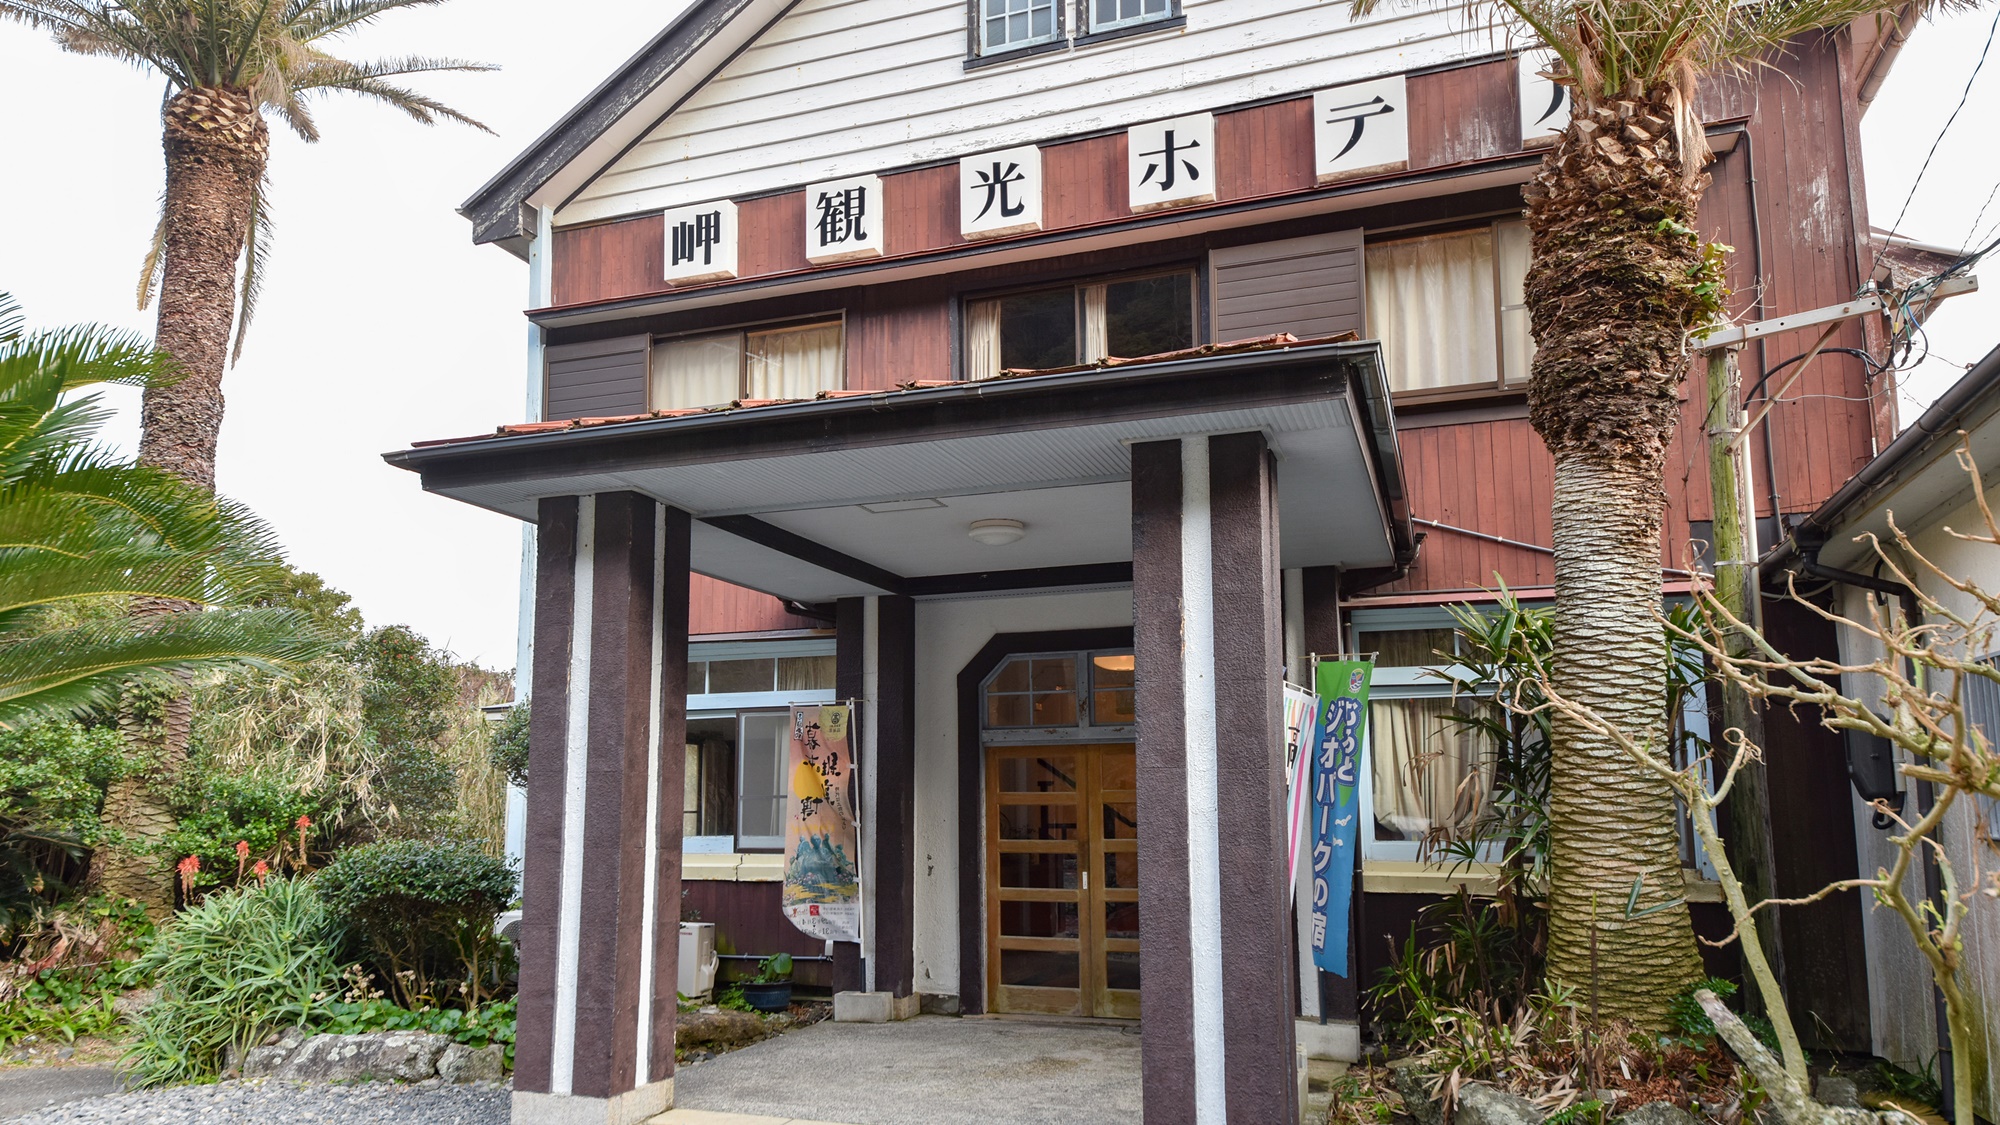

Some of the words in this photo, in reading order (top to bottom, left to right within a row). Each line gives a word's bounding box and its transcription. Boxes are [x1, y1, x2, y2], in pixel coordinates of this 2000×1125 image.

[1313, 701, 1345, 950] ジオパークの宿
